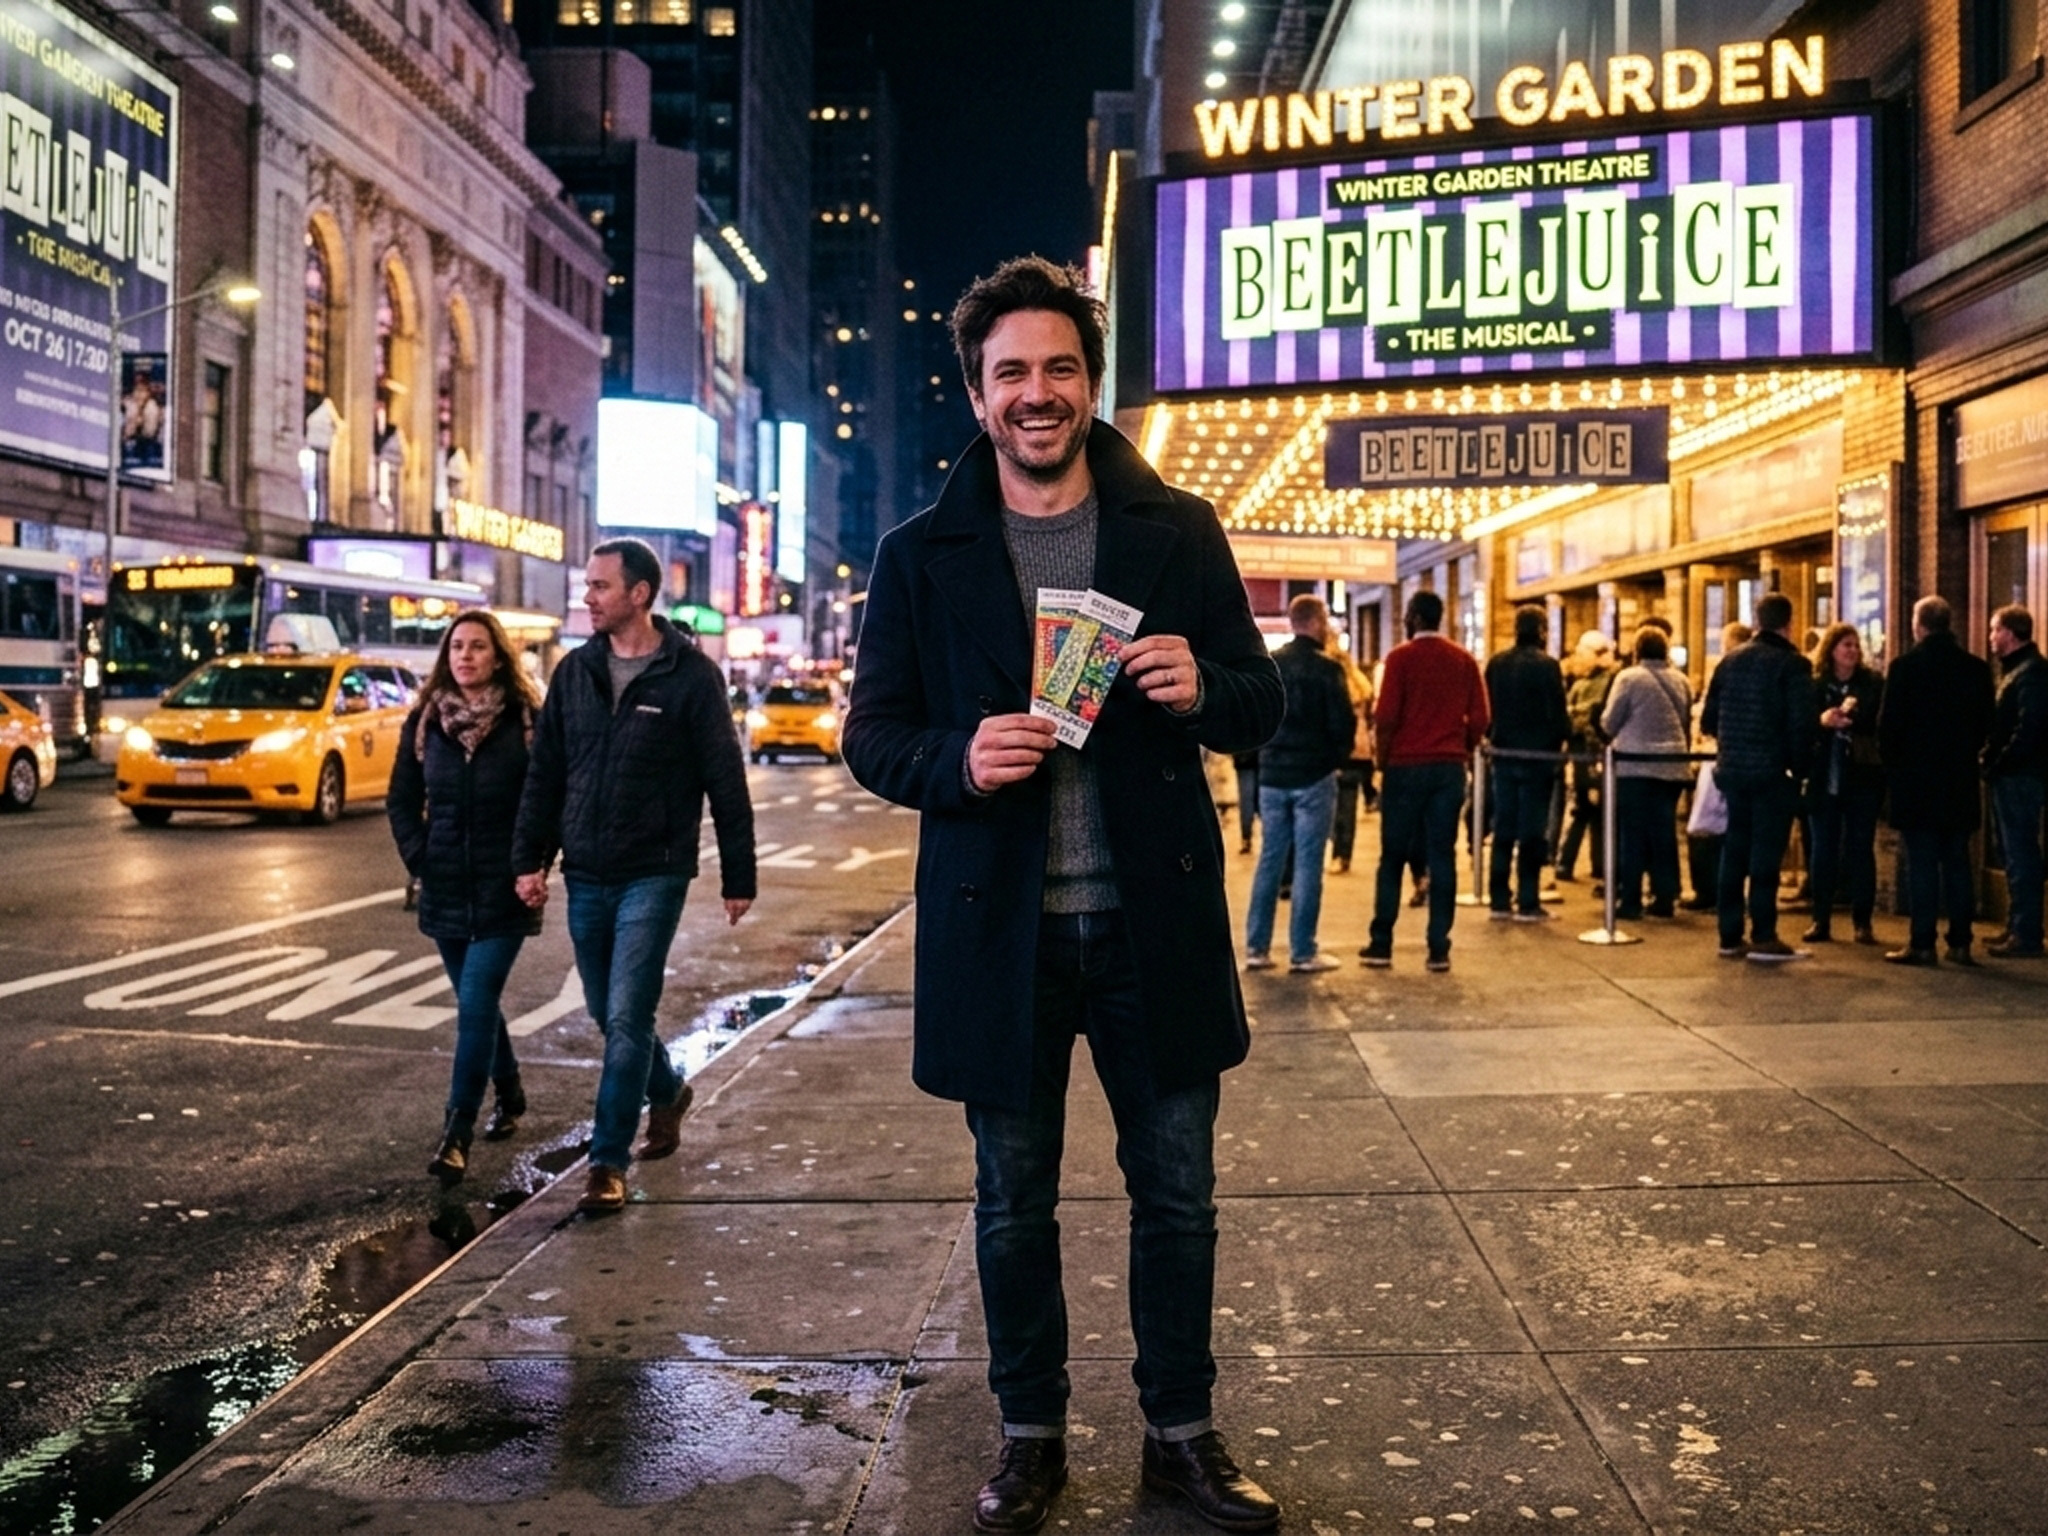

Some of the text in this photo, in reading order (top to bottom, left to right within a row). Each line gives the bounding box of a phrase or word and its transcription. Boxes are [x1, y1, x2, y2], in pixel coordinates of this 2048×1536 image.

[1194, 35, 1824, 158] WINTER GARDEN
[1336, 154, 1650, 203] WINTER GARDEN THEATRE
[58, 245, 113, 288] MUSICA
[5, 317, 43, 353] OCT
[1406, 320, 1576, 351] THE MUSICAL
